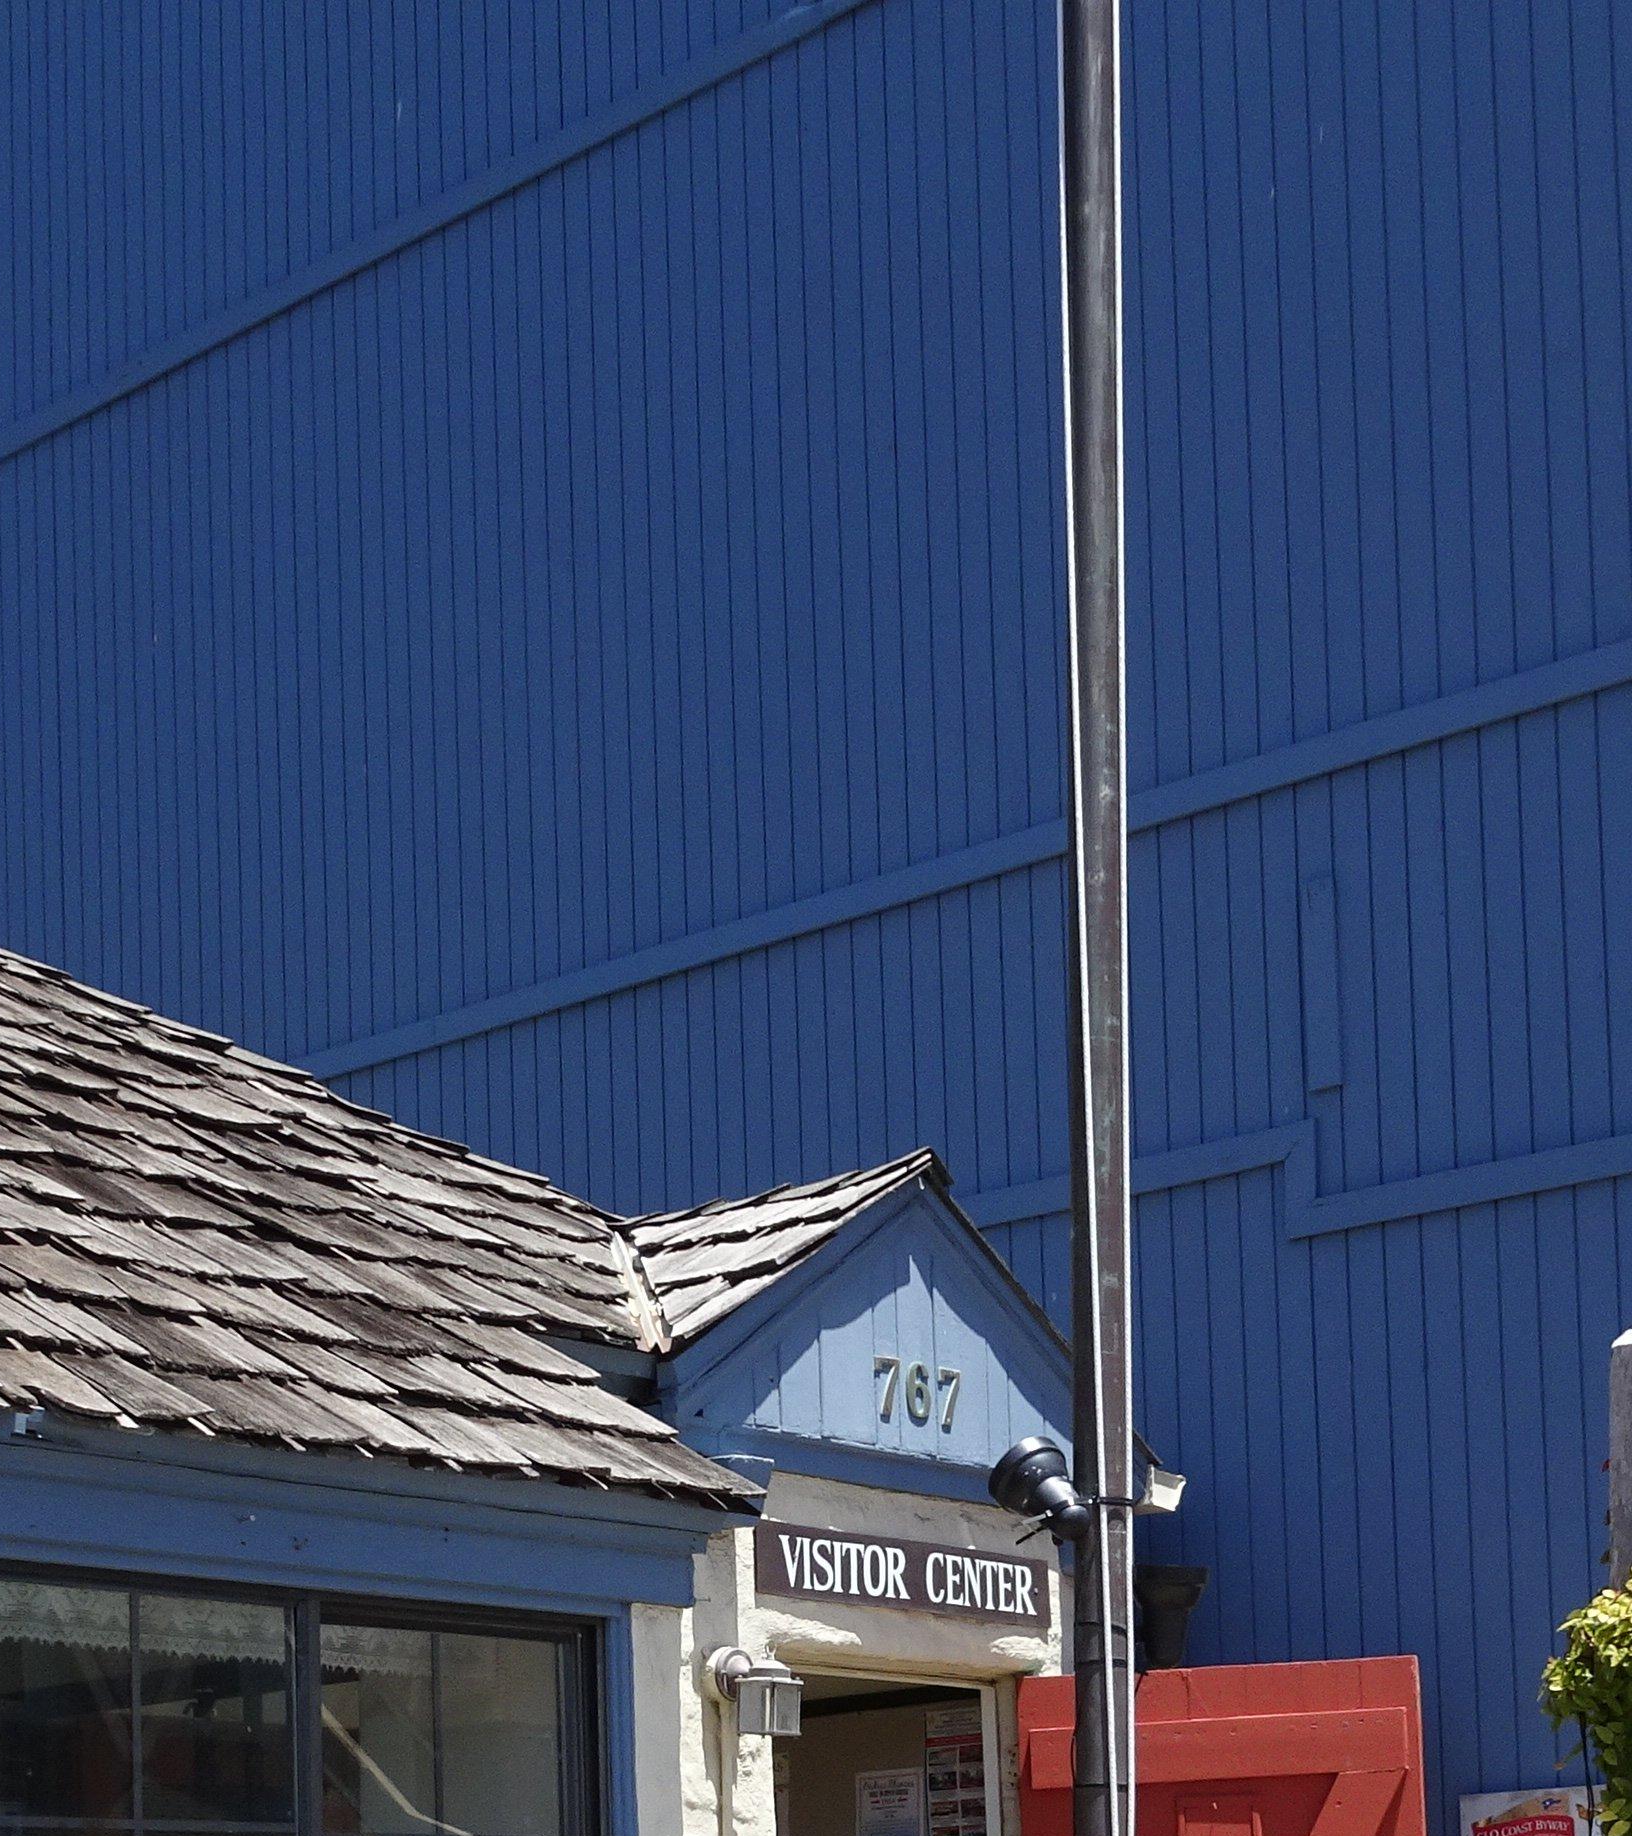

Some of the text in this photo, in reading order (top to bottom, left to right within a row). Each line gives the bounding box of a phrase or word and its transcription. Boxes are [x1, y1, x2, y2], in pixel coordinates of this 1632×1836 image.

[873, 1356, 962, 1429] 767
[779, 1534, 1037, 1616] VISITOR CENTER
[1535, 1819, 1569, 1832] BYWAY
